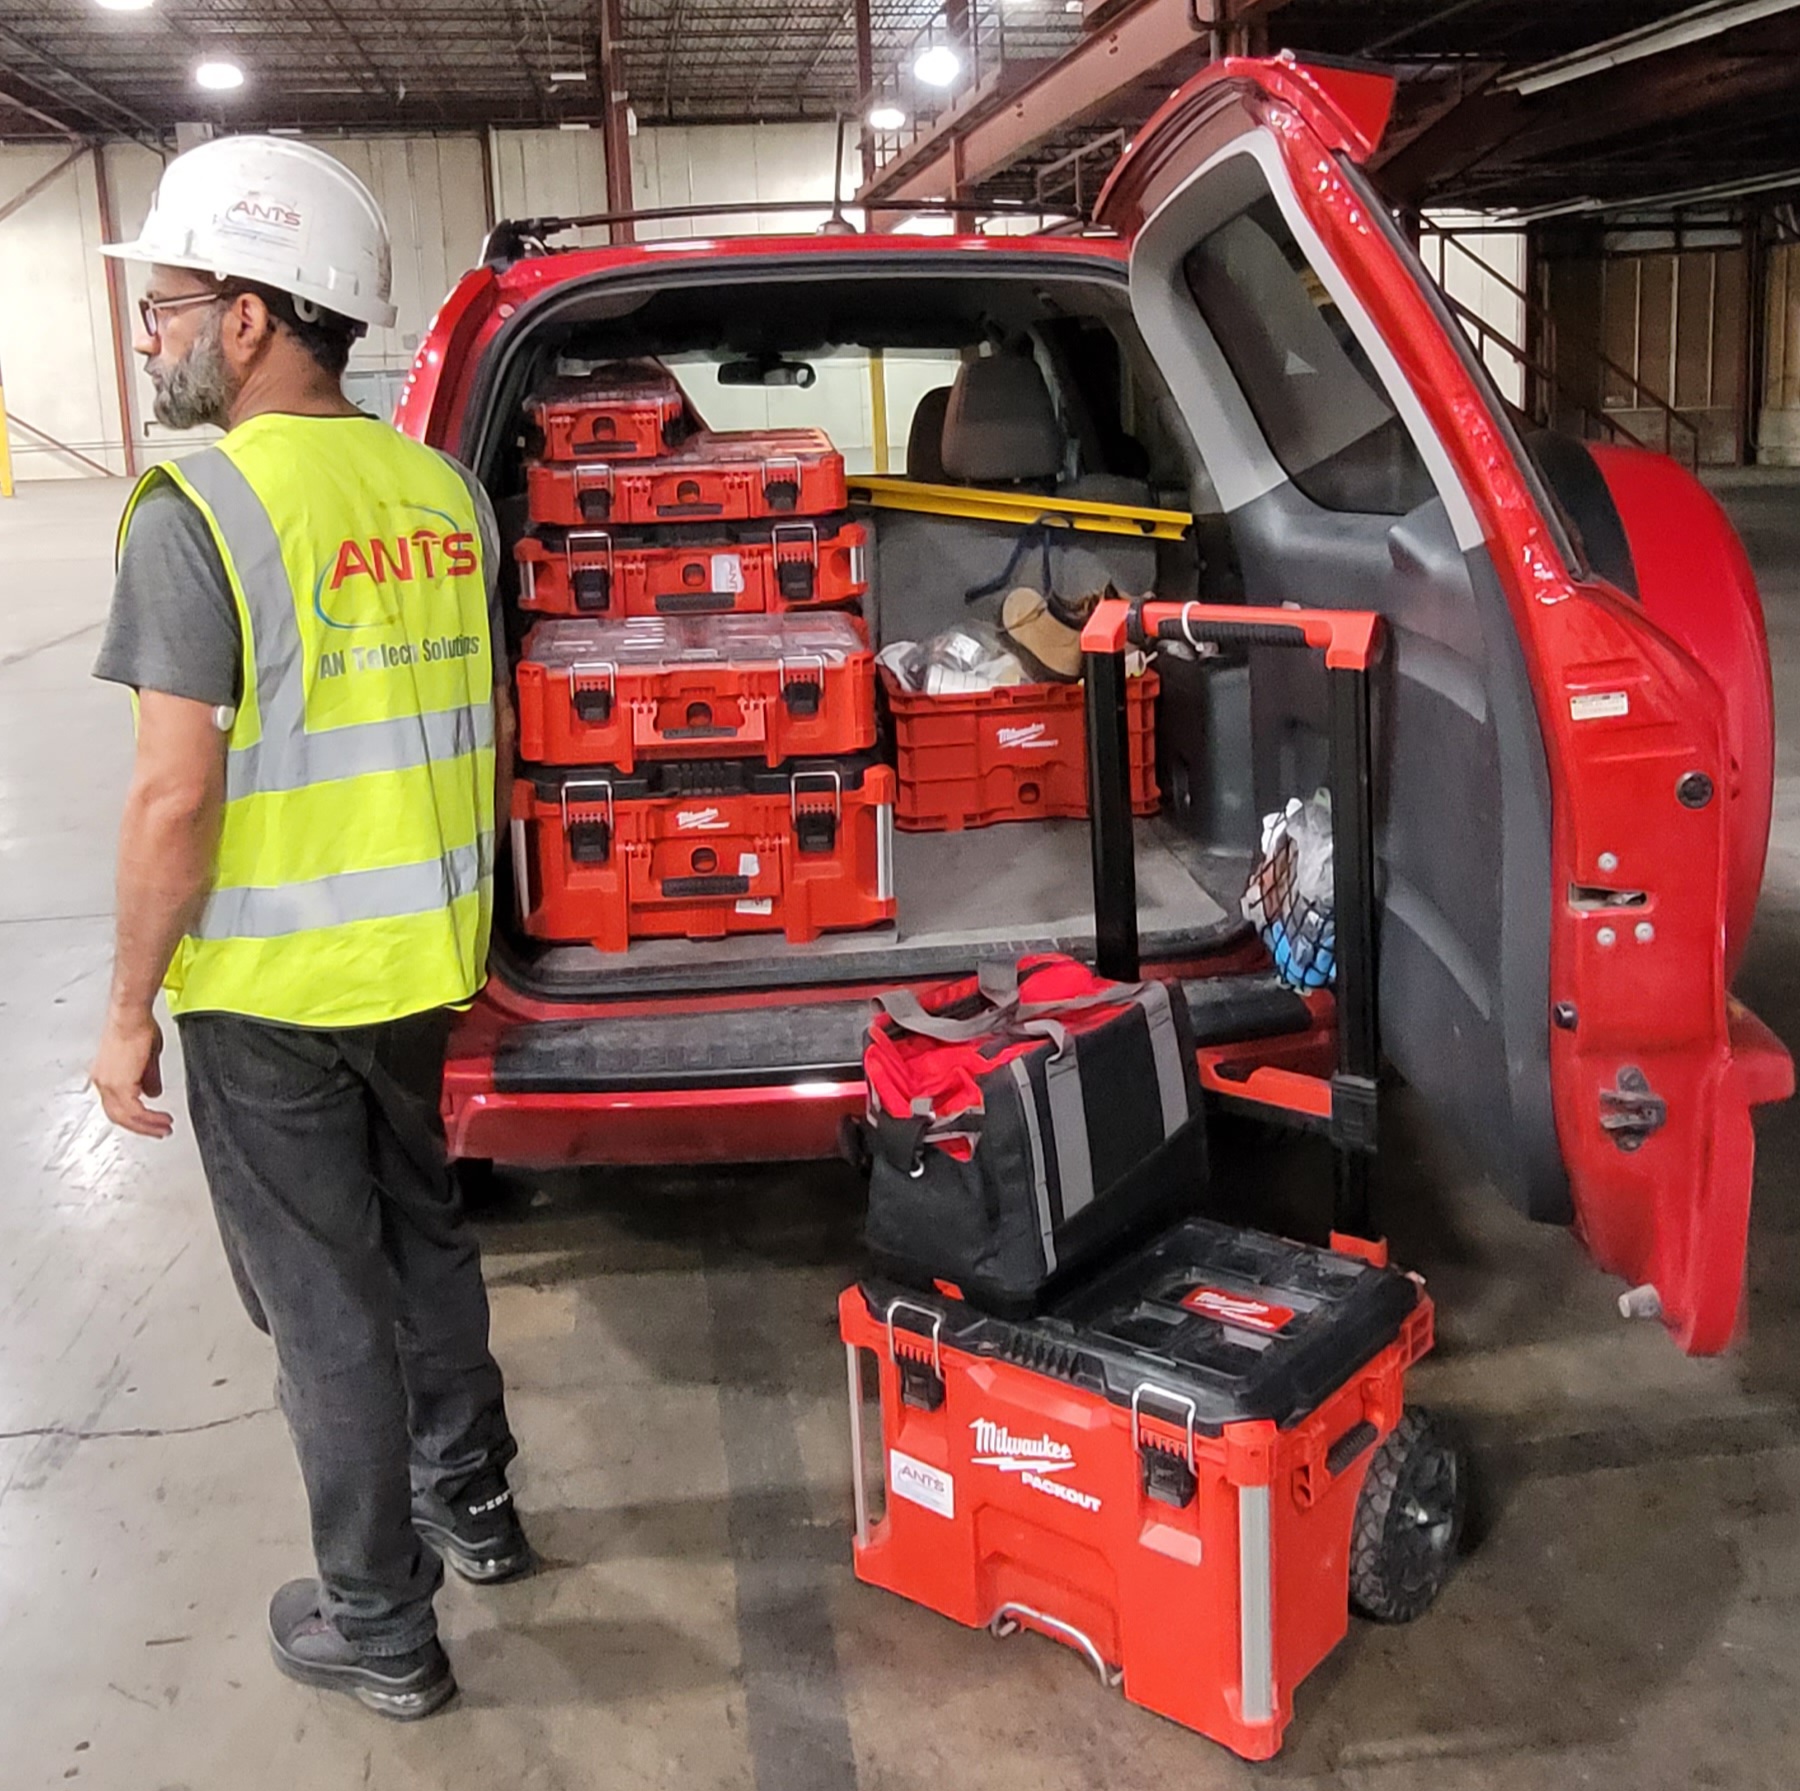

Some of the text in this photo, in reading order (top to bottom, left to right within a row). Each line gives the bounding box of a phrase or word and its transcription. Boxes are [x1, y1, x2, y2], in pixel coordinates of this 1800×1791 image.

[232, 200, 301, 226] ANTS
[329, 529, 477, 590] ANTS
[320, 650, 346, 679] AN
[968, 1417, 1072, 1459] Milwaukee
[1022, 1471, 1102, 1513] PACKOUT
